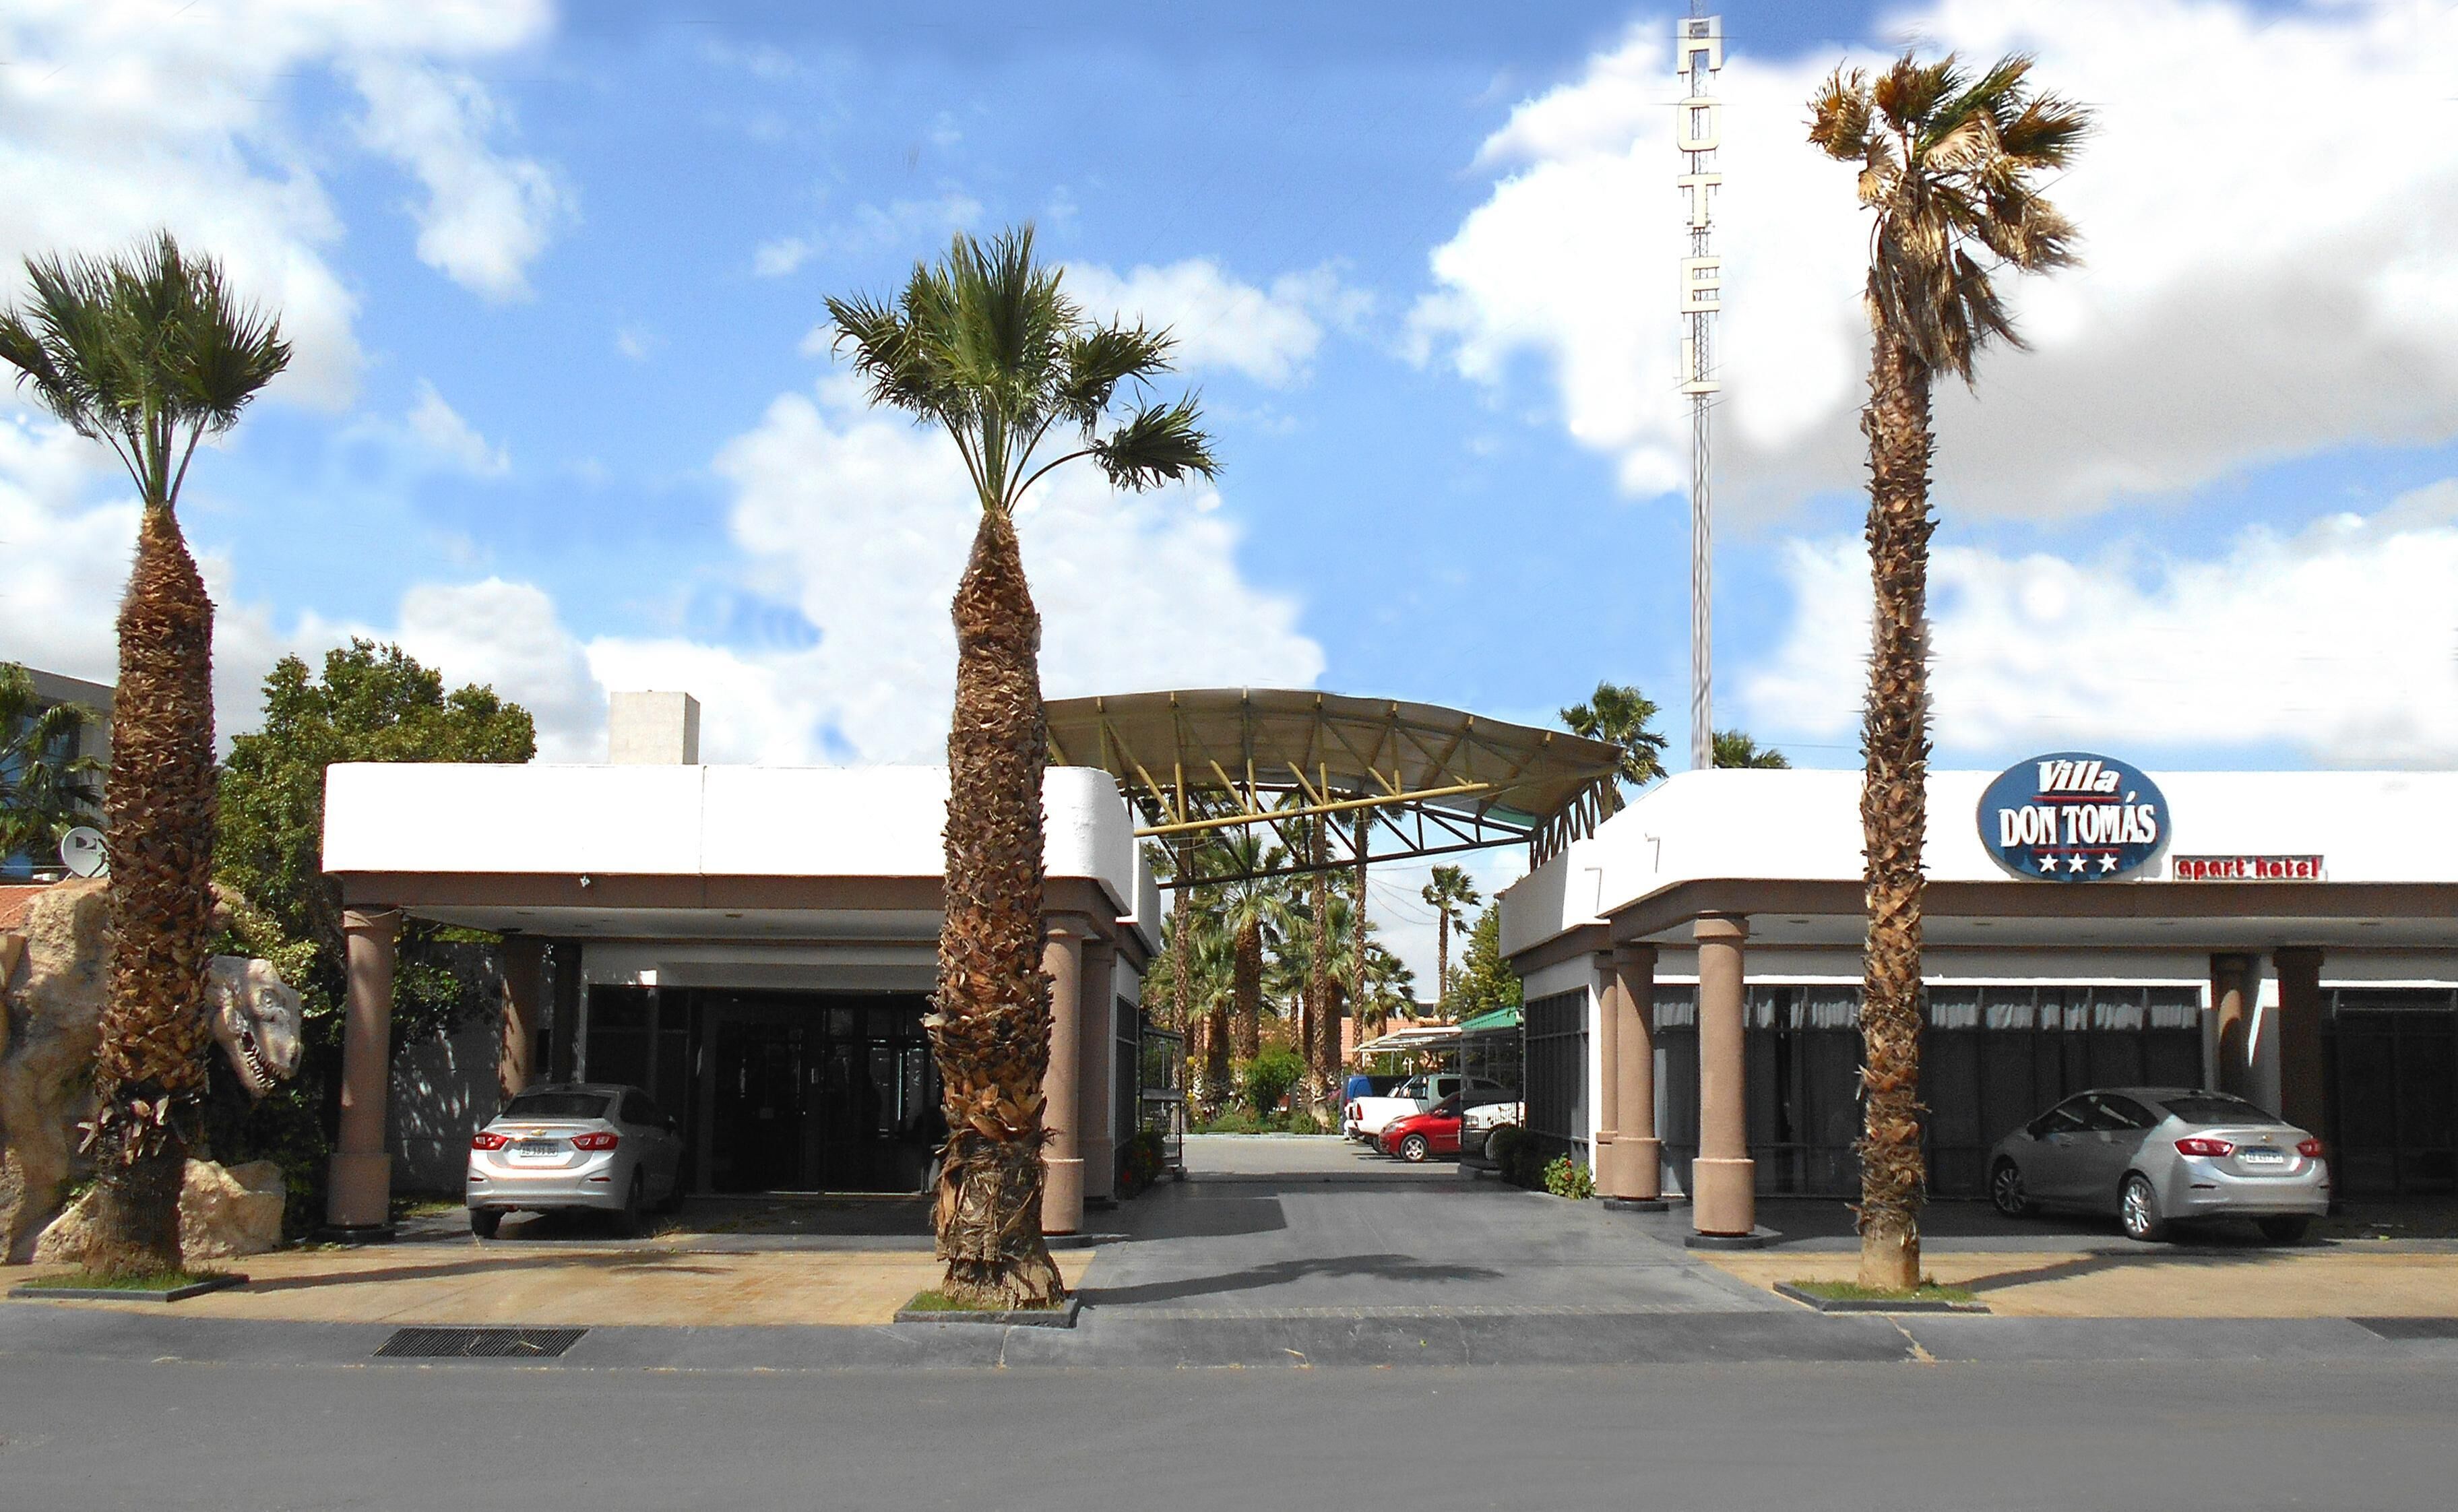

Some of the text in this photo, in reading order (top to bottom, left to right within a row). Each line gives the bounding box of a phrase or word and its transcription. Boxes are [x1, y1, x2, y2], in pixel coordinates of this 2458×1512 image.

[1677, 15, 1722, 394] HOTEL
[2038, 759, 2120, 792] Villa
[1998, 791, 2157, 847] DON TOMÁS
[2178, 856, 2319, 880] apart hotel
